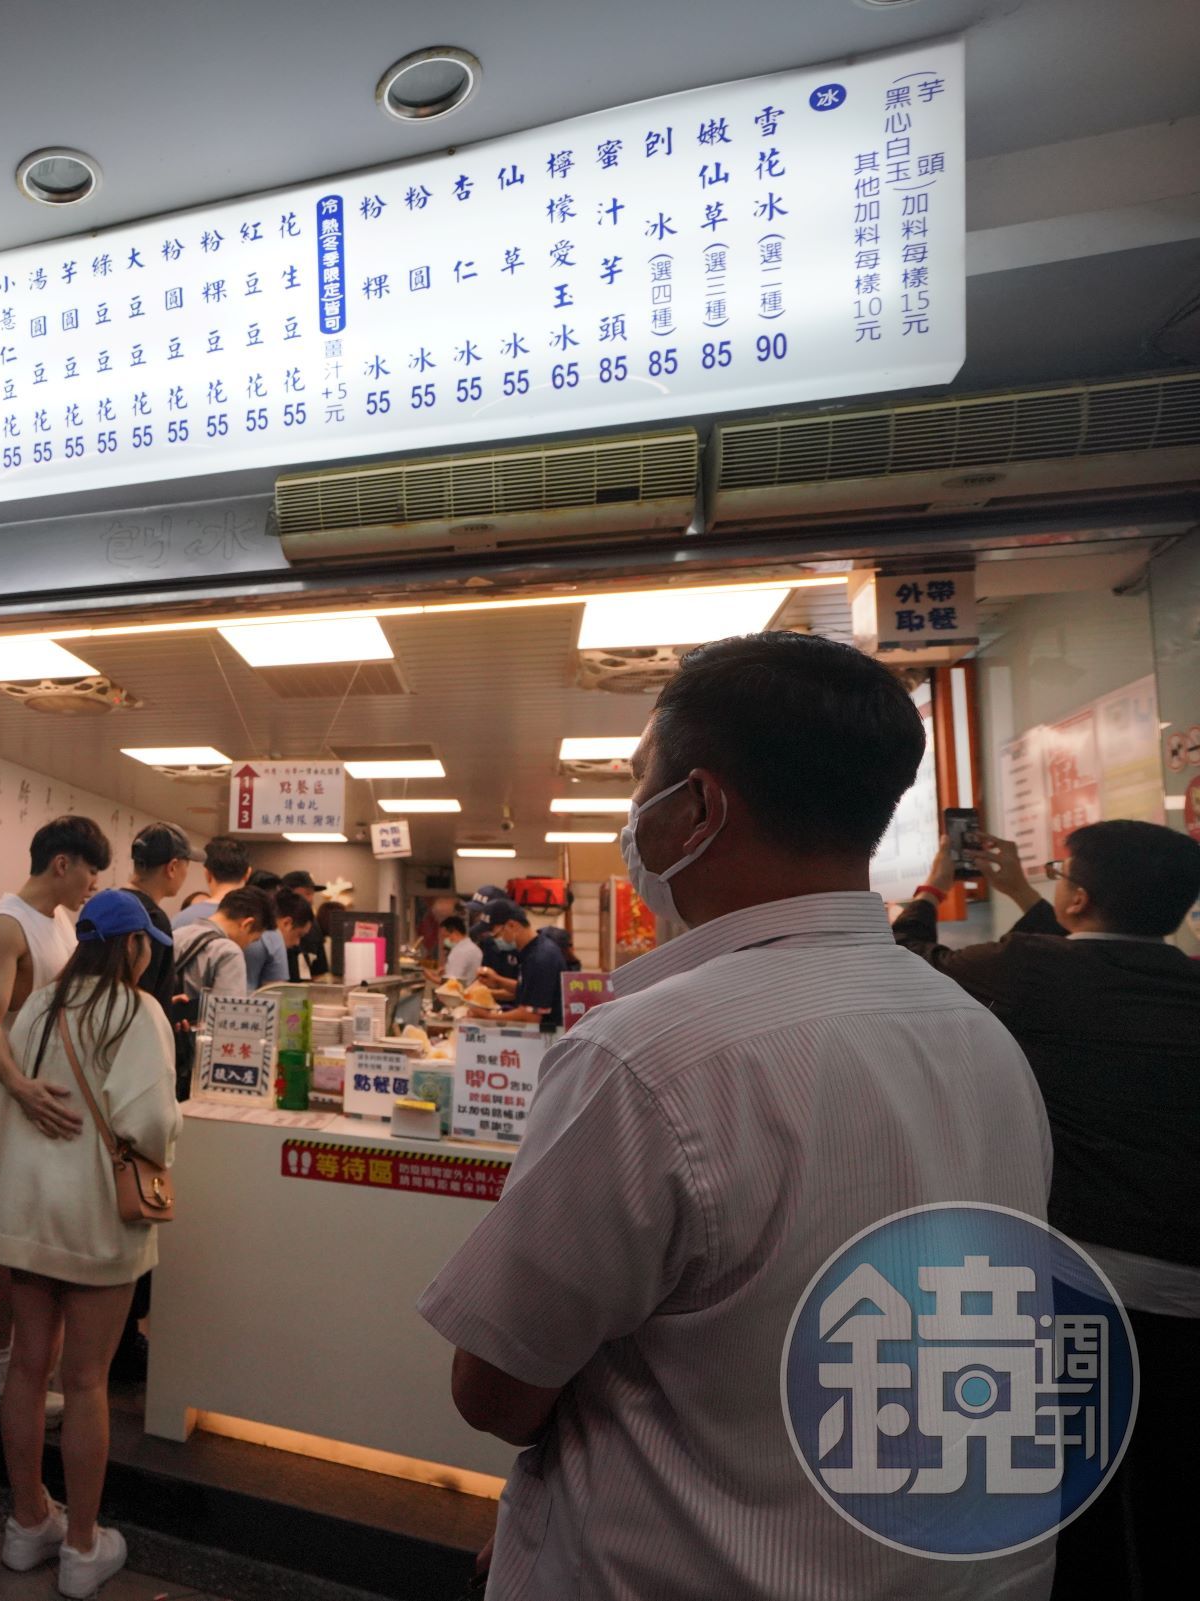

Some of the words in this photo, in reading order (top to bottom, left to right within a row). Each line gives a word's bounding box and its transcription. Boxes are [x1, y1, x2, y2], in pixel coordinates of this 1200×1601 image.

[816, 87, 839, 108] 冰
[697, 117, 732, 327] 嫩仙草(選三種)
[753, 106, 788, 319] 雪花冰(選二種)
[596, 140, 627, 341] 蜜汁芋頭
[645, 127, 677, 336] 刨冰(選四種)
[546, 150, 580, 351] 檸檬愛玉冰
[854, 152, 881, 342] 其他加料每樣10元
[453, 175, 482, 366] 杏仁冰
[498, 165, 530, 359] 仙草冰
[360, 195, 390, 380] 粉粿冰
[404, 185, 436, 372] 粉圓冰
[702, 340, 732, 369] 85
[756, 333, 787, 362] 90
[552, 362, 579, 389] 65
[600, 355, 628, 383] 85
[649, 348, 678, 377] 85
[411, 383, 436, 409] 55
[457, 376, 482, 403] 55
[503, 369, 530, 396] 55
[284, 402, 306, 426] 55
[367, 390, 390, 415] 55
[168, 419, 189, 443] 55
[207, 413, 228, 437] 55
[246, 408, 268, 432] 55
[65, 436, 84, 458] 55
[97, 430, 117, 453] 55
[133, 425, 153, 448] 55
[3, 446, 21, 468] 55
[34, 441, 52, 463] 55
[896, 580, 955, 603] 外帶
[243, 777, 250, 788] 1
[242, 794, 250, 806] 2
[241, 811, 249, 823] 3
[354, 1073, 409, 1095] 點餐區
[316, 1153, 393, 1184] 等待區
